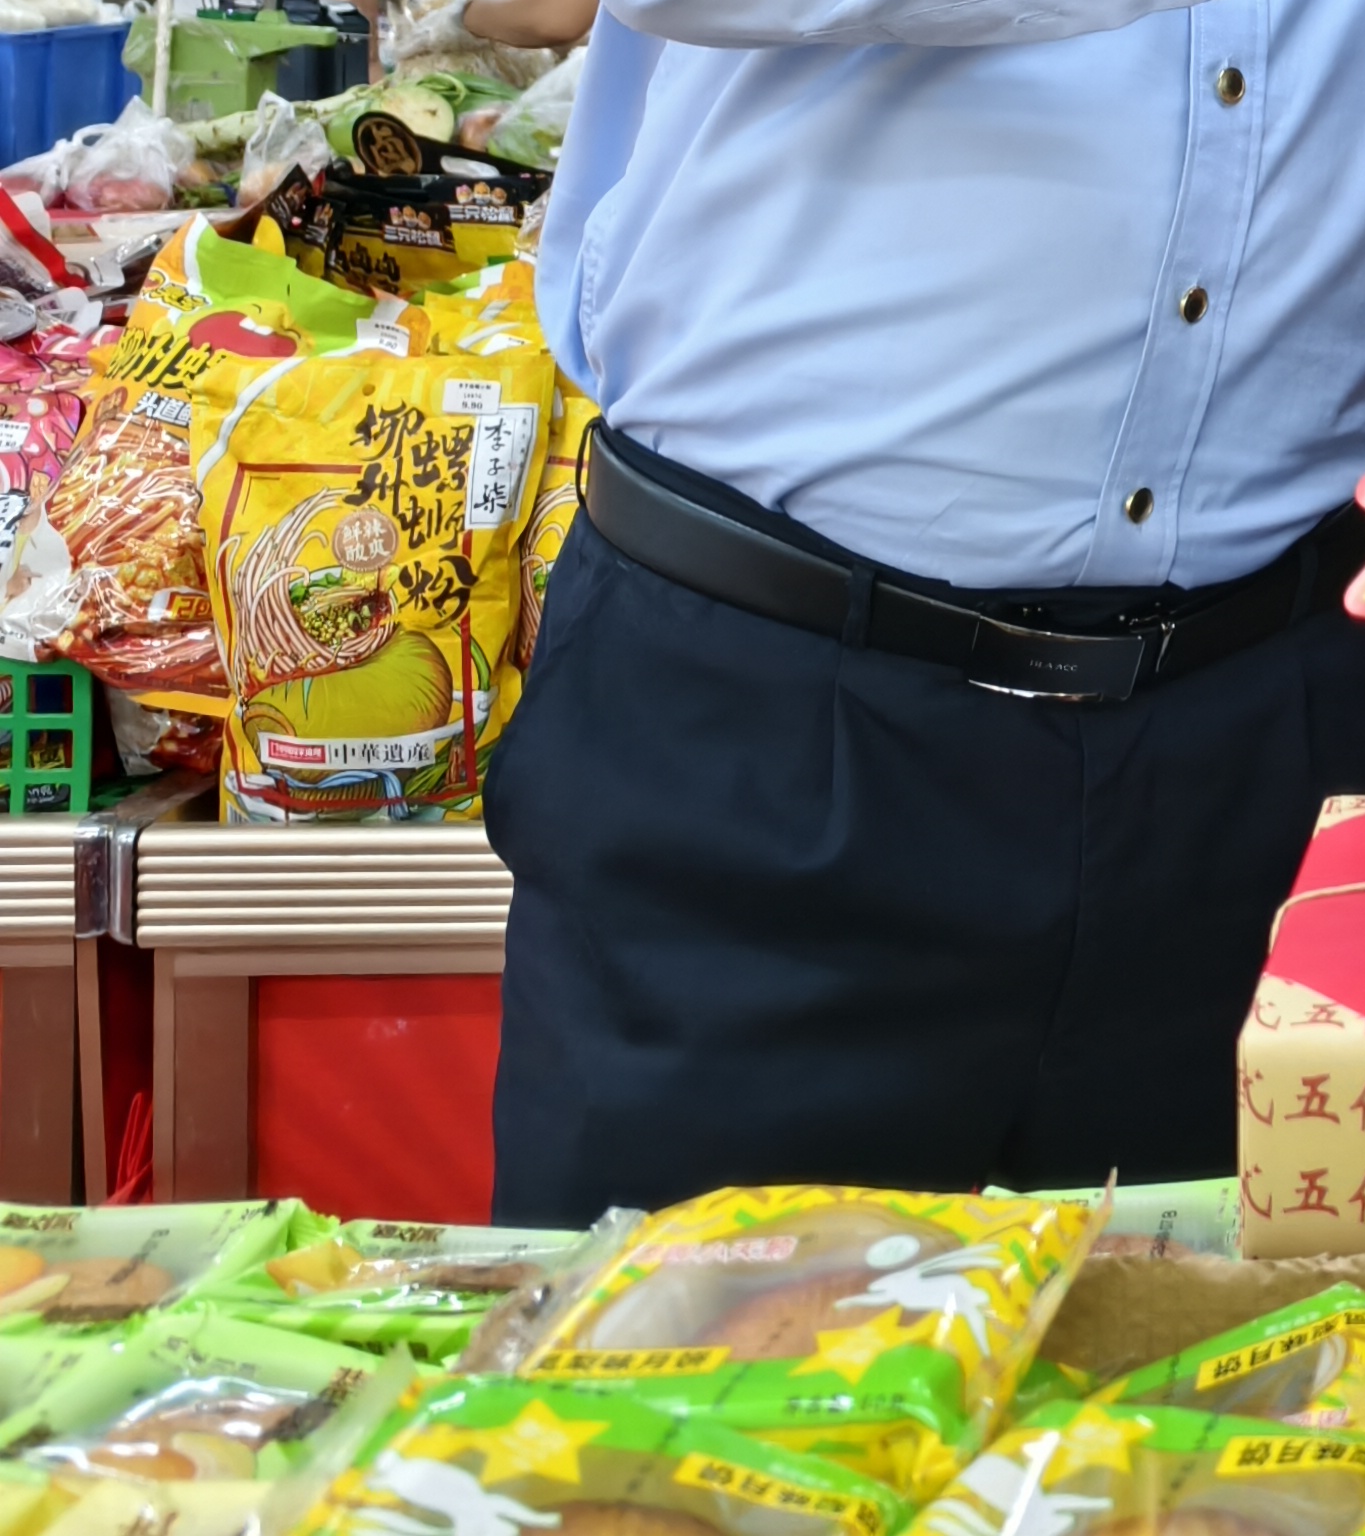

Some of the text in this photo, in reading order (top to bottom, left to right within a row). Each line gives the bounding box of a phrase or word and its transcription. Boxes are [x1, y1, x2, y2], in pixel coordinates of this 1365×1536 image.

[462, 401, 483, 410] 9.90
[473, 418, 512, 514] 李子柒
